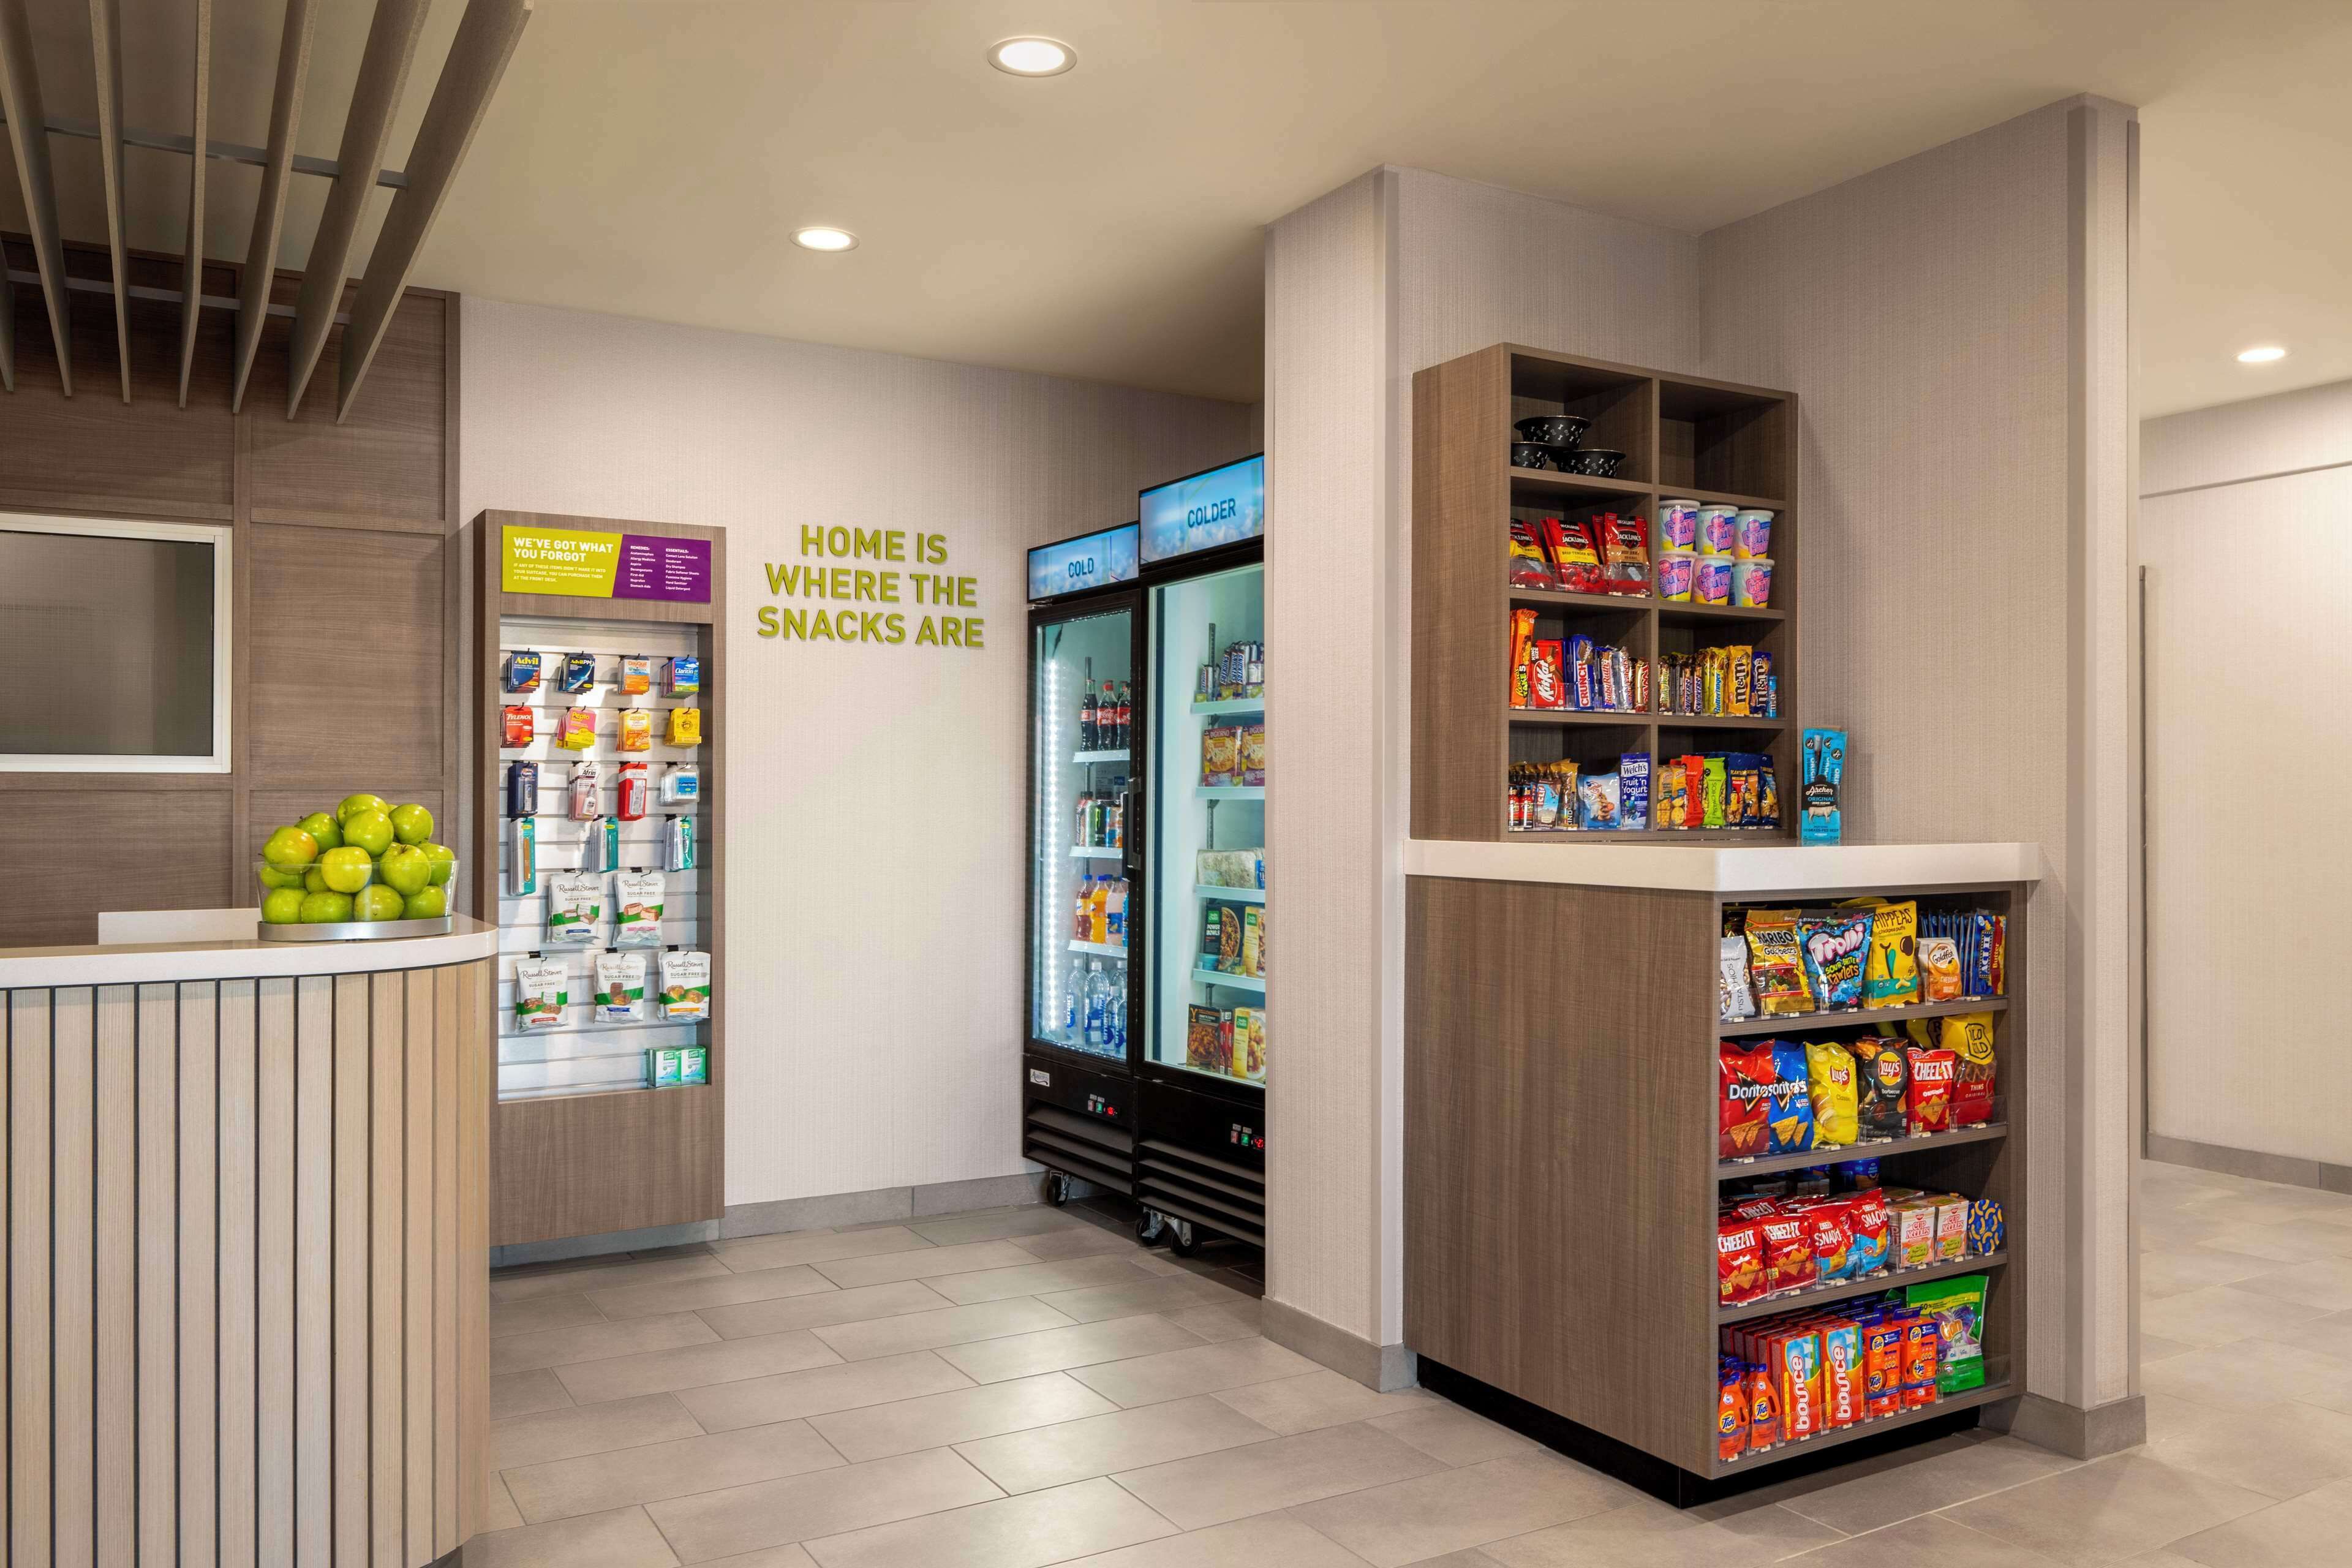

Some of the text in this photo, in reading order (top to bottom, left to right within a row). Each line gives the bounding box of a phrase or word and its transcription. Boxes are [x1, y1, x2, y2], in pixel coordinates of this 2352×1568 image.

[1187, 497, 1236, 529] COLDER
[513, 537, 613, 554] WE'VE GOT WHAT
[801, 524, 948, 564] HOME IS
[514, 549, 586, 562] YOU FORGOT
[1068, 557, 1094, 579] COLD
[765, 563, 978, 606] WHERE THE
[757, 606, 985, 647] SNACKS ARE
[514, 657, 539, 665] Advil
[1520, 673, 1529, 697] TAKE
[1537, 660, 1555, 701] KitKat
[1578, 663, 1590, 707] CRUNCH
[572, 712, 590, 720] Pepto
[1623, 763, 1647, 774] Welch's
[1622, 786, 1648, 795] Yogurt
[1806, 786, 1833, 796] Archer
[1755, 930, 1794, 946] HARIBO
[1809, 923, 1864, 963] Trolli
[666, 960, 686, 969] Russell
[1932, 949, 1954, 964] Goldfish
[521, 970, 544, 980] Russell
[1825, 962, 1842, 974] SOUR
[1830, 1066, 1849, 1085] Lay's
[1880, 1060, 1900, 1077] Lay's
[1915, 1061, 1953, 1080] CHEEZ-IT
[1729, 1083, 1774, 1100] Doritos
[1773, 1080, 1807, 1095] oritos
[1738, 1202, 1776, 1220] CHEEZ-IT
[1949, 1214, 1960, 1223] CUP
[1906, 1226, 1931, 1238] NOODLES
[1913, 1220, 1926, 1229] CUP
[1942, 1220, 1964, 1232] NOODLES
[1717, 1230, 1755, 1253] CHEEZ-IT
[1873, 1340, 1884, 1349] Tide
[1833, 1346, 1851, 1420] bounce
[1869, 1376, 1882, 1387] Tide
[1792, 1356, 1811, 1431] bounce
